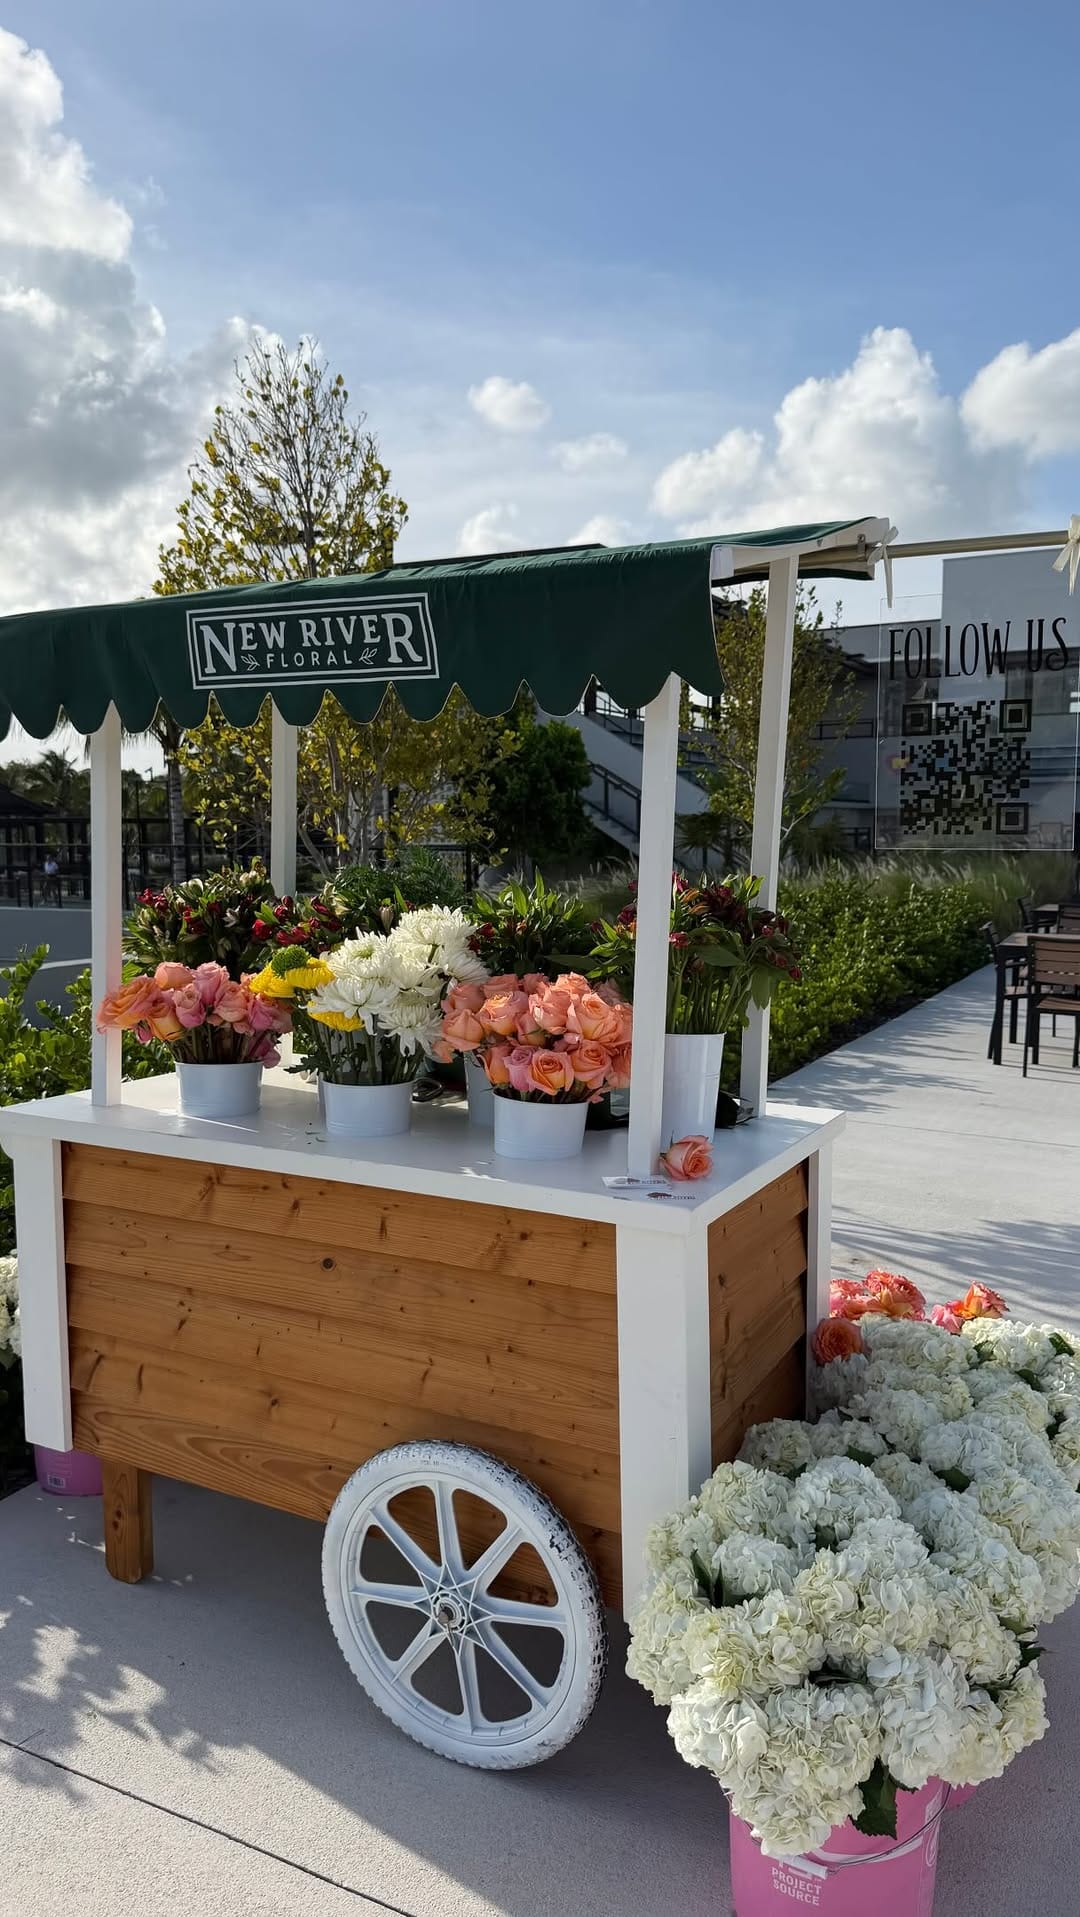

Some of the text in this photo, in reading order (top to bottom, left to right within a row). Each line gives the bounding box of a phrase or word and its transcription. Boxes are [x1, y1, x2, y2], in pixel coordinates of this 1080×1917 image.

[199, 612, 424, 674] NEW RIVER
[888, 616, 1069, 680] FOLLOW US
[266, 650, 353, 669] FLORAL
[771, 1867, 822, 1895] PROJECT
[772, 1878, 820, 1906] SOURCE
